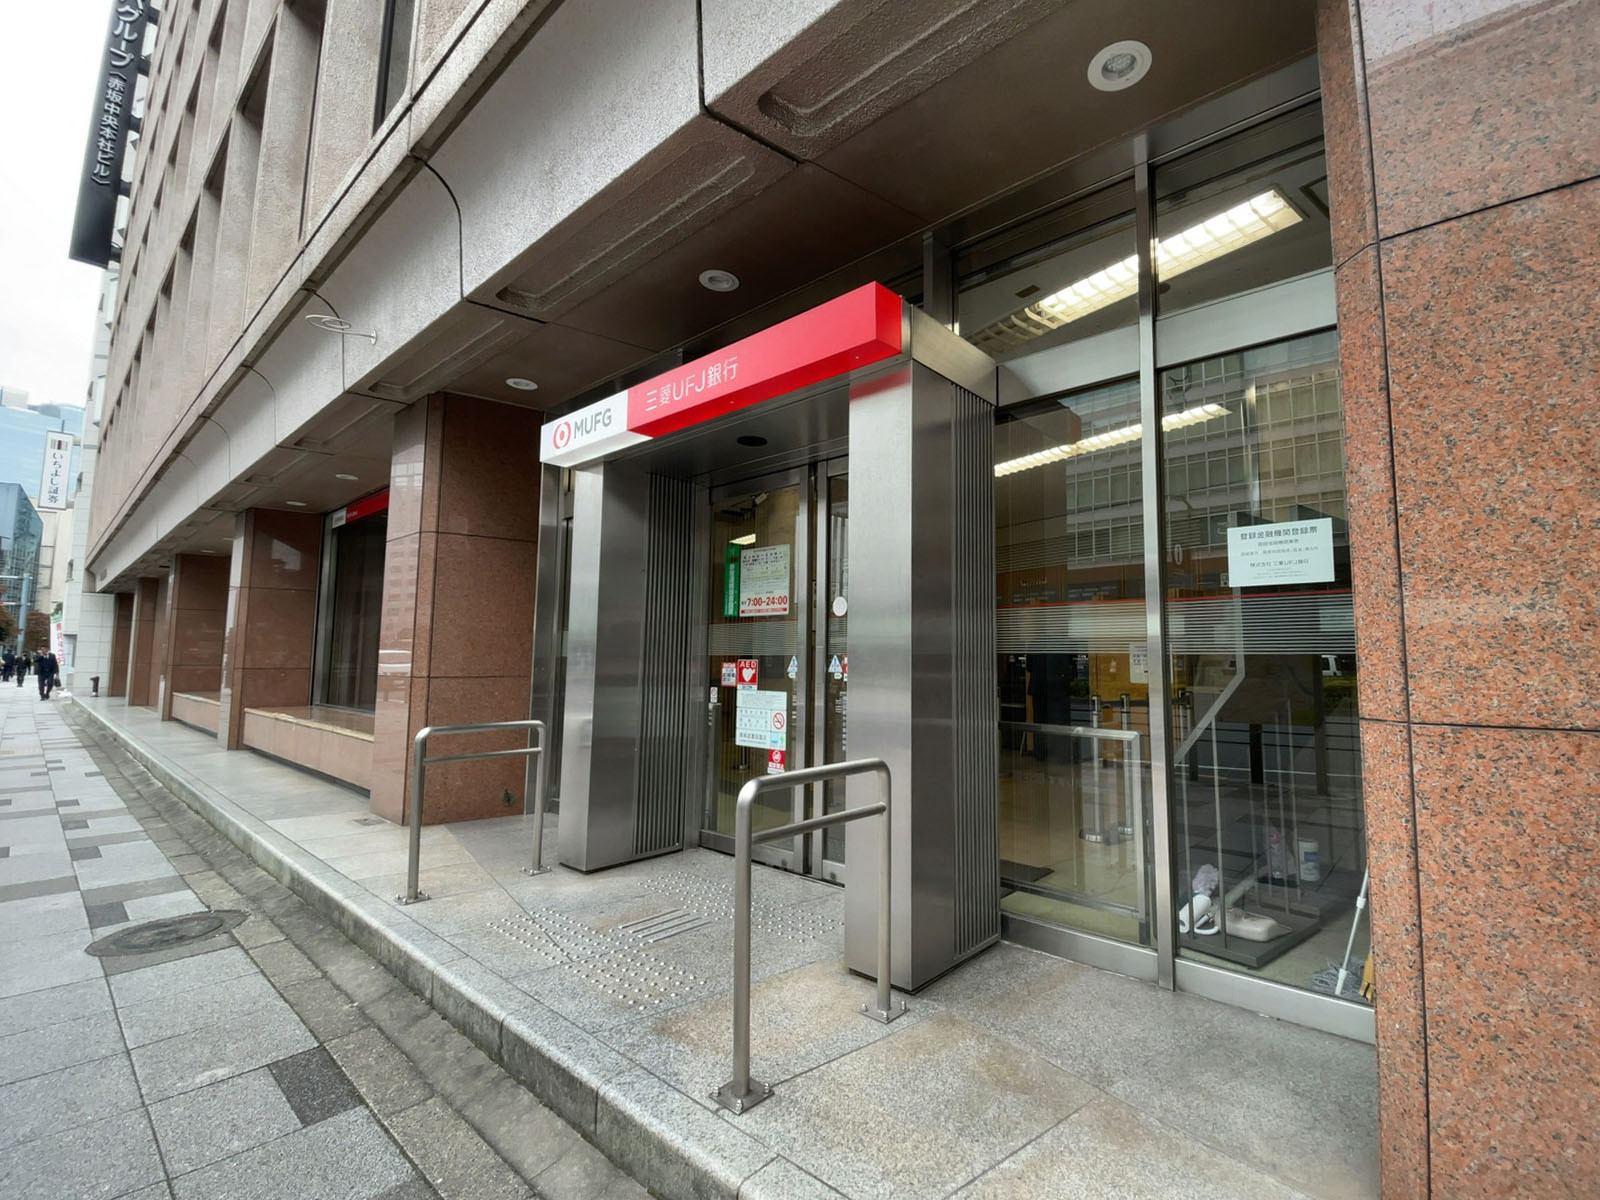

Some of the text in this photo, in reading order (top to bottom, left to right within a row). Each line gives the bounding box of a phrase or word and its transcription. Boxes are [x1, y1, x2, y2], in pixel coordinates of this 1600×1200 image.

[645, 355, 738, 412] 三菱UFJ銀行
[574, 408, 612, 439] MUFG
